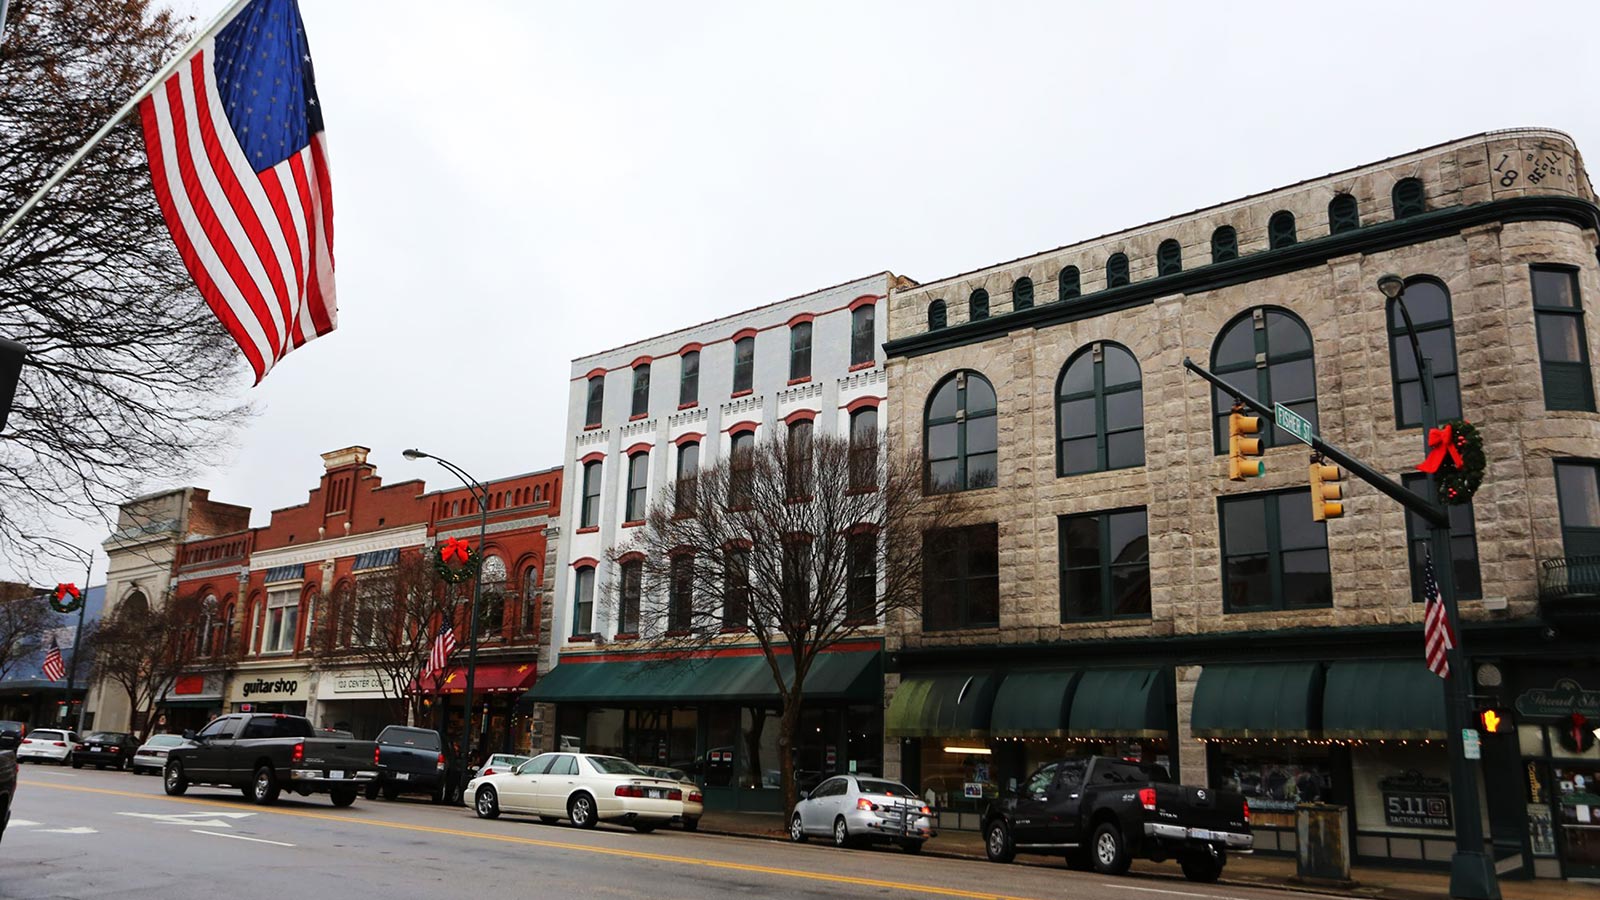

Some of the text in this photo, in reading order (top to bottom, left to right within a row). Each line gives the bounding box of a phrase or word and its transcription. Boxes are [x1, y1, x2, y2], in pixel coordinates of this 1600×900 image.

[1494, 154, 1519, 187] 18
[1278, 407, 1310, 443] FISHER ST
[348, 680, 370, 688] CENTER
[371, 679, 391, 687] CORT
[1388, 796, 1426, 815] 5.11
[1390, 816, 1449, 826] TACTICAL SERIES
